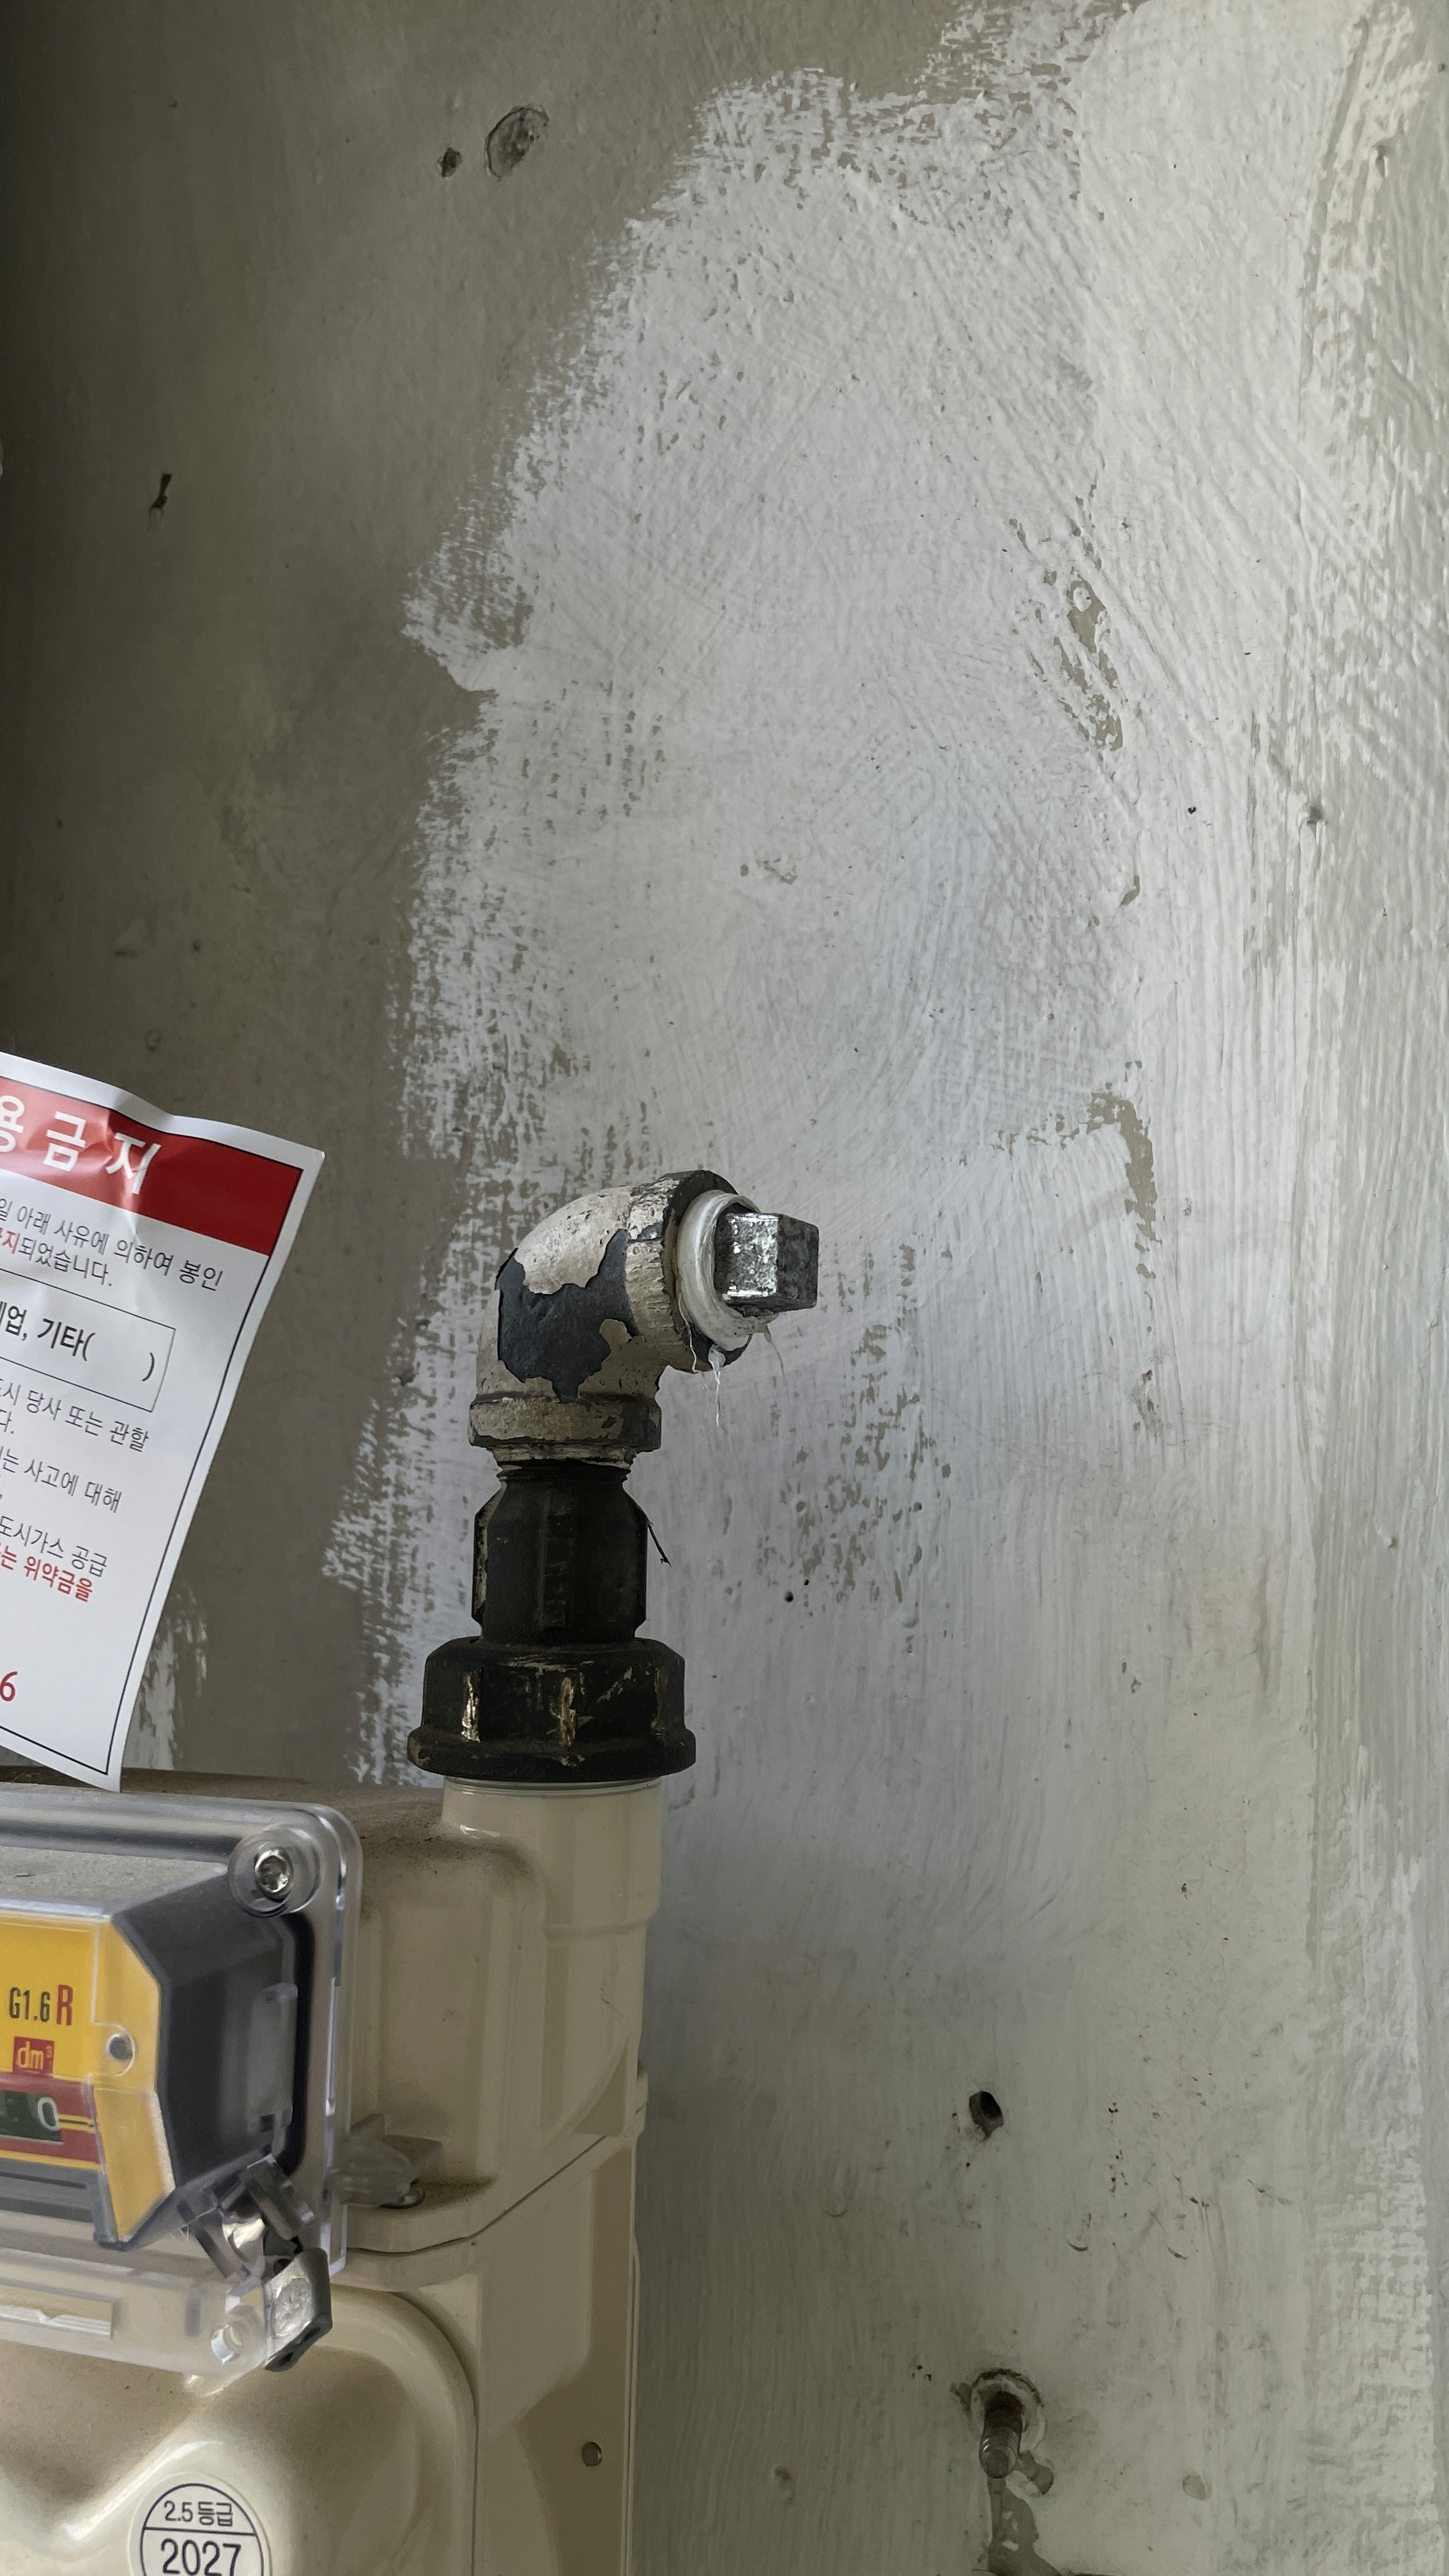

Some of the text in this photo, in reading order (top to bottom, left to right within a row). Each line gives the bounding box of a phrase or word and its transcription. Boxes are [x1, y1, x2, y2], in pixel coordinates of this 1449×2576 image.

[0, 1227, 112, 1286] 지되었습니다.
[17, 1206, 51, 1235] 아래
[54, 1220, 109, 1255] 사유에
[114, 1239, 174, 1276] 의하여
[180, 1260, 223, 1291] 봉인
[0, 1377, 150, 1452] 시 당사 또는 관할
[0, 1446, 123, 1514] 는 사고에 대해
[0, 1515, 107, 1577] 도시가스 공급
[0, 1542, 93, 1602] 는 위약금을
[0, 1671, 18, 1701] 6
[161, 2538, 241, 2576] 2027
